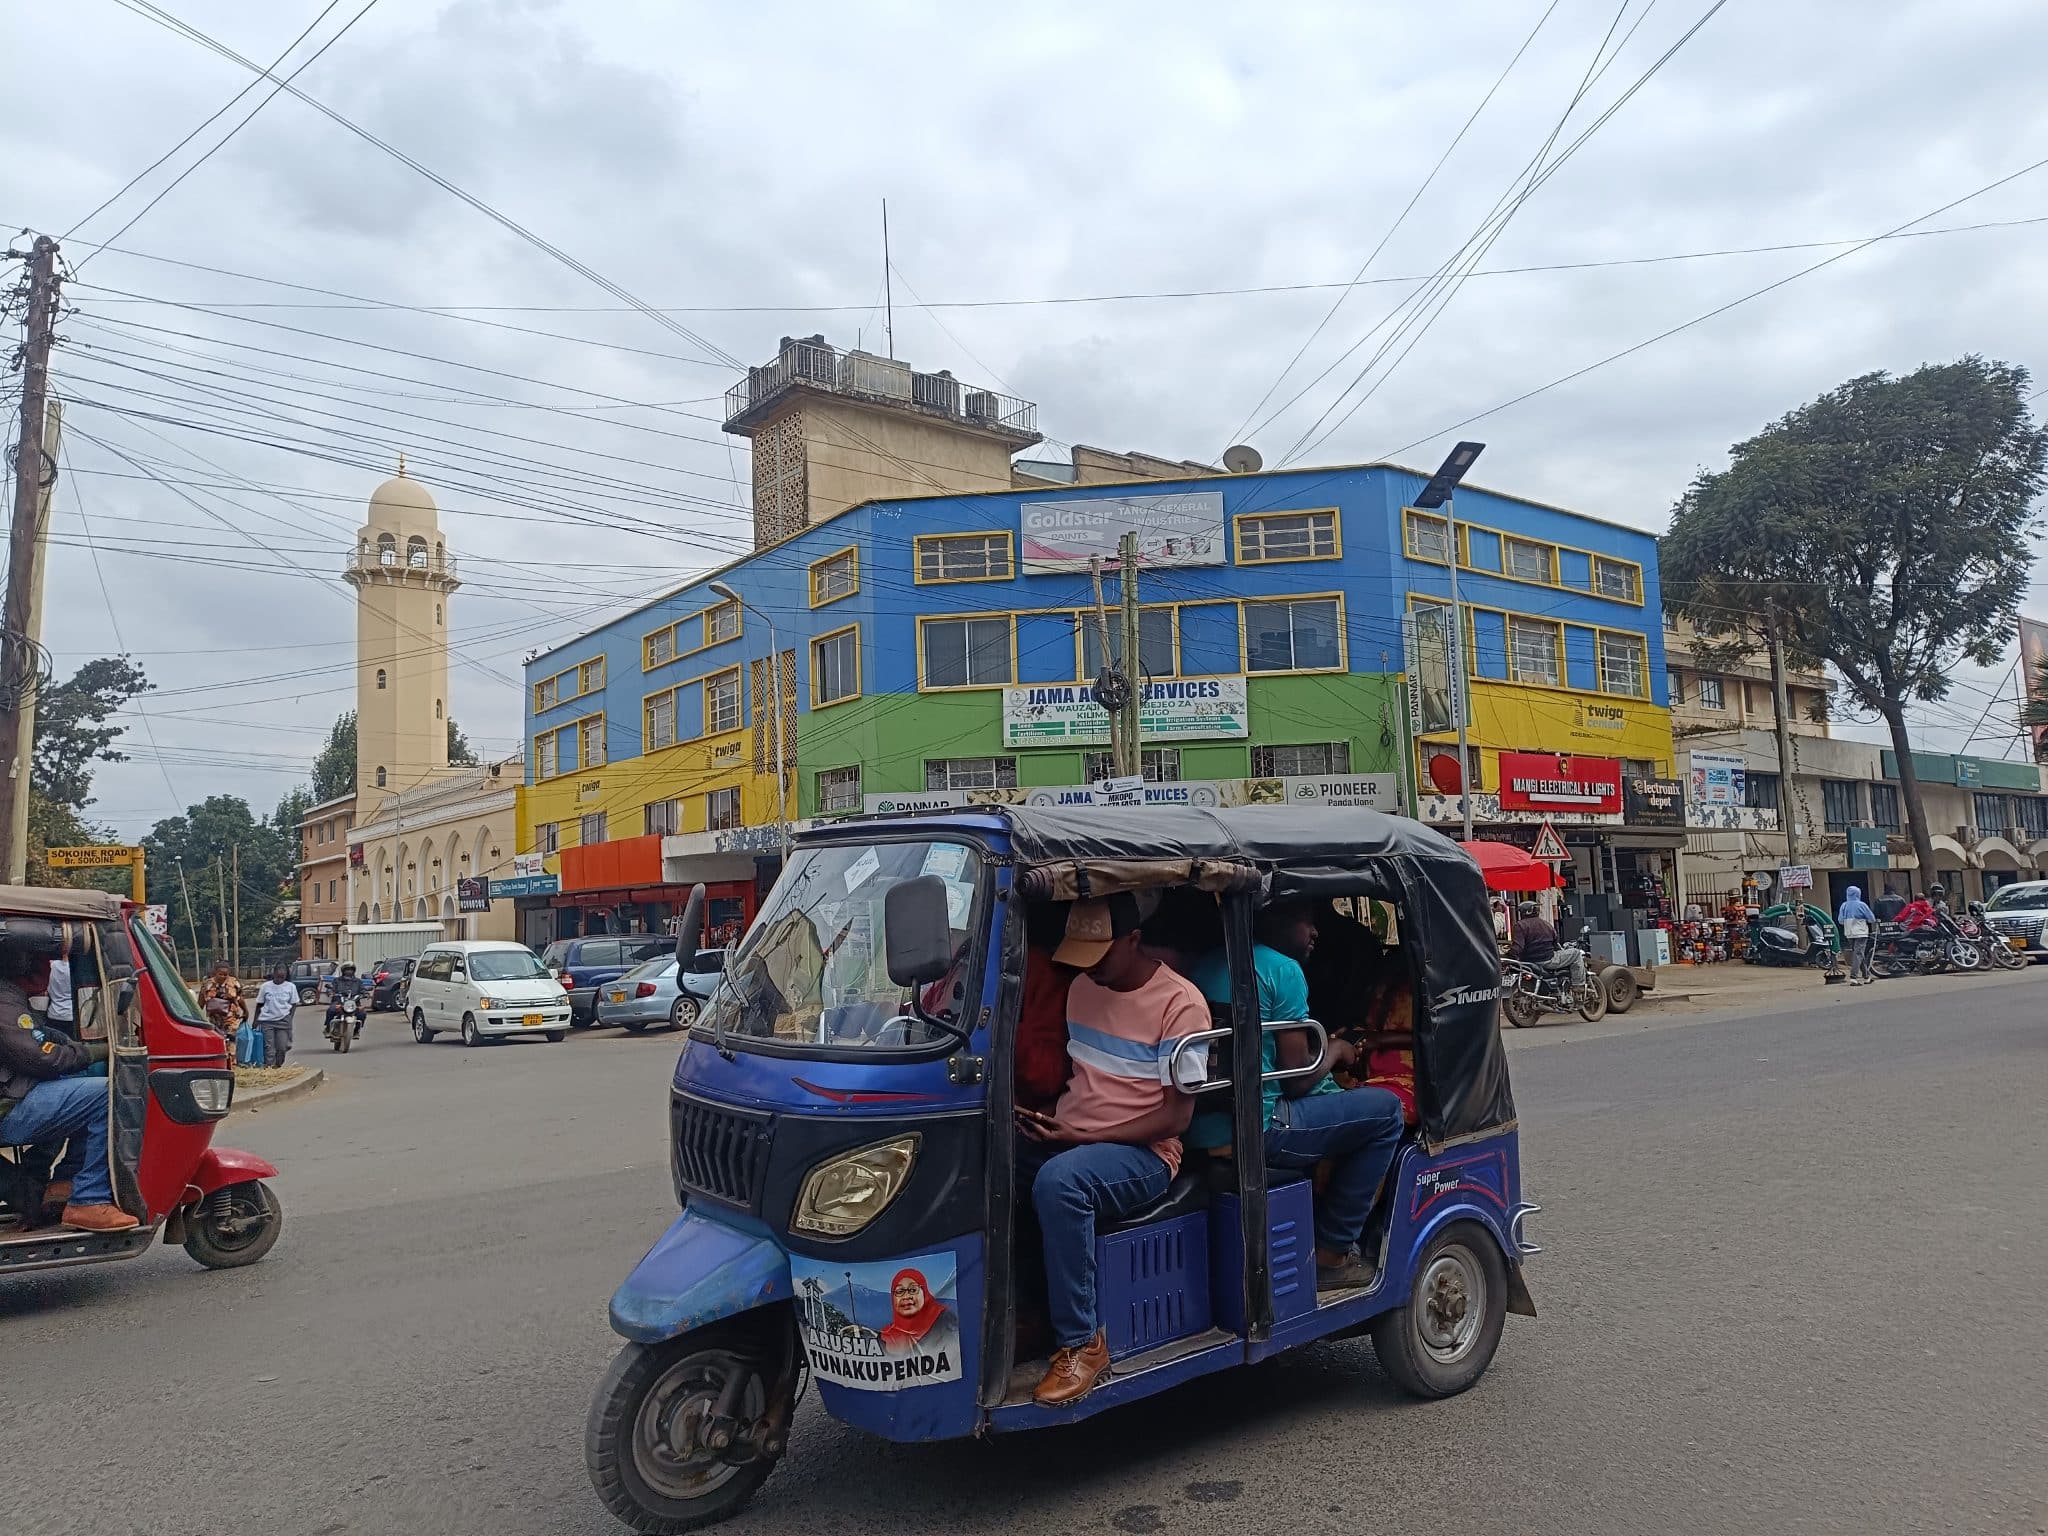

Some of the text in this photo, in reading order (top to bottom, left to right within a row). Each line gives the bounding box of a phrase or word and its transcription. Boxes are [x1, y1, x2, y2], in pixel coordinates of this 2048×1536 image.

[1158, 502, 1211, 513] GENERAL
[1026, 511, 1112, 528] Goldstar
[1133, 516, 1199, 527] INDUSTRIES
[1051, 532, 1089, 540] PAINTS
[1028, 687, 1074, 705] JAMA
[1144, 681, 1220, 700] ERVICES
[1408, 674, 1419, 717] PANNAR
[1055, 704, 1100, 713] WAUZAJI
[1178, 700, 1192, 708] ZA
[1587, 704, 1624, 720] twiga
[715, 740, 742, 758] twiga
[581, 779, 601, 793] twiga
[1320, 782, 1377, 797] PIONEER
[1512, 778, 1616, 796] MANGI ELECTRICAL & LIGHTS
[1058, 787, 1189, 805] JAMA RVICES
[1108, 791, 1134, 803] MKOPO
[1327, 798, 1354, 807] Panda
[1650, 793, 1672, 810] depot
[51, 849, 128, 858] SOKOINE ROAD
[78, 855, 115, 864] SOKOINE
[1416, 1171, 1441, 1187] Super
[1434, 1177, 1460, 1194] Power
[808, 1328, 885, 1357] ARUSHA
[809, 1351, 951, 1382] TUNAKUPENDA
